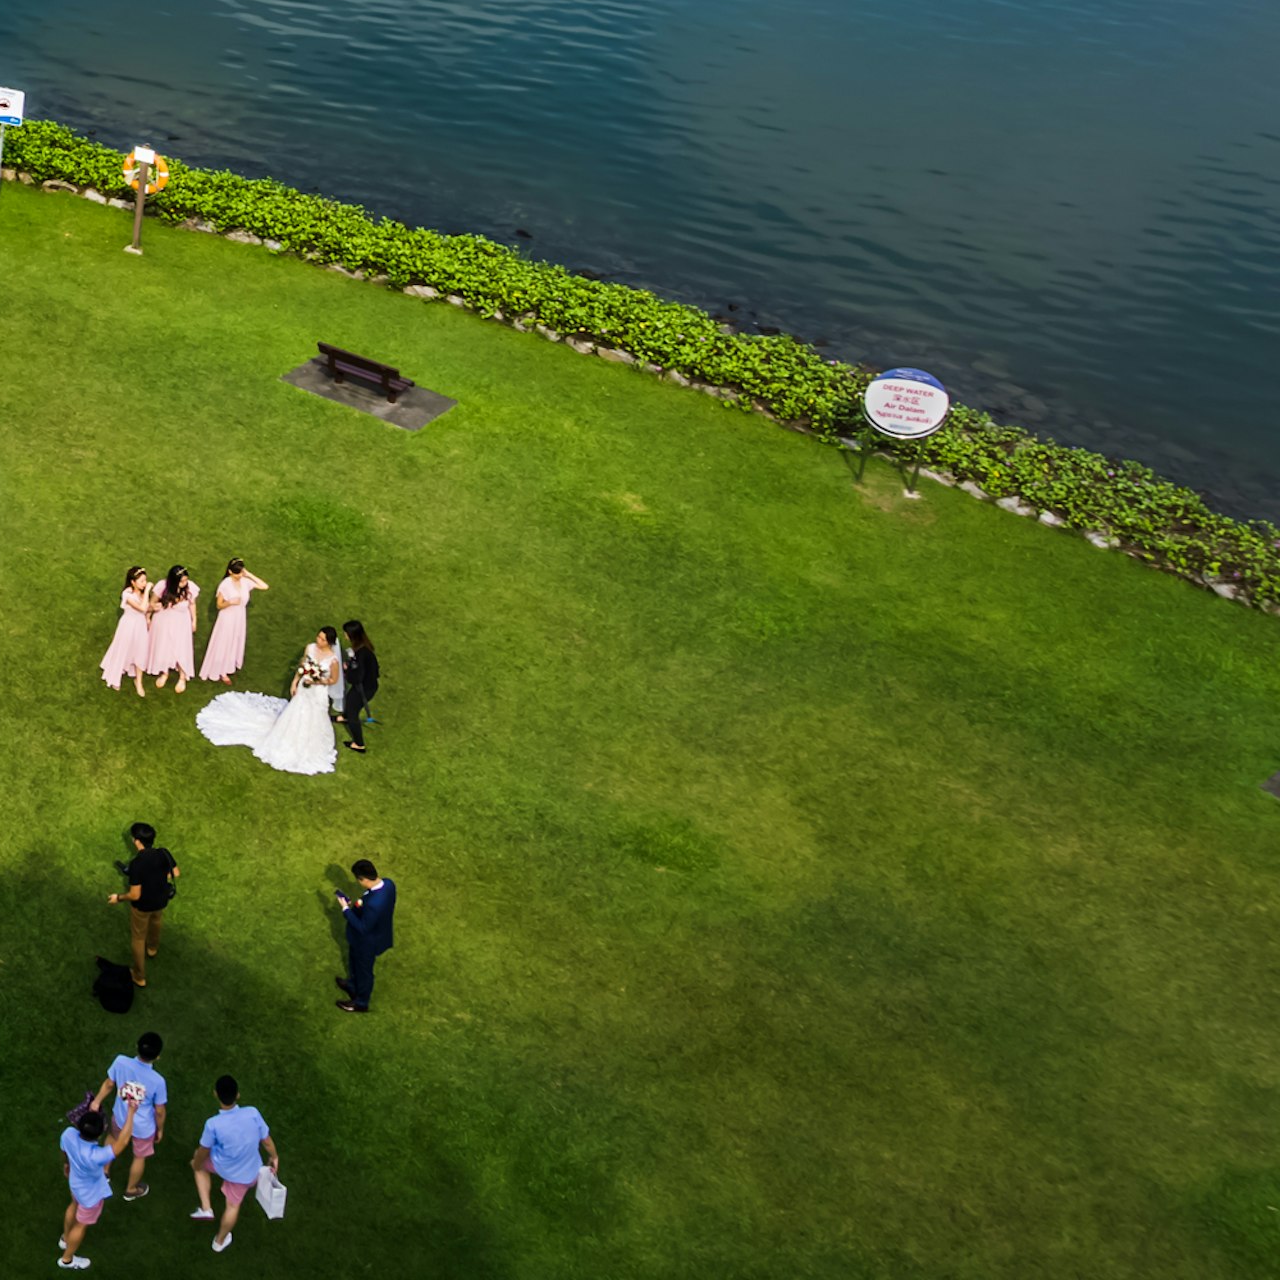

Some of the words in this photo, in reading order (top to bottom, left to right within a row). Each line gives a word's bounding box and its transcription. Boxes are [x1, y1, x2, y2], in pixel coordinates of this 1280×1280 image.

[883, 384, 904, 392] DEEP
[906, 389, 934, 397] WATER
[899, 405, 925, 414] Dalam
